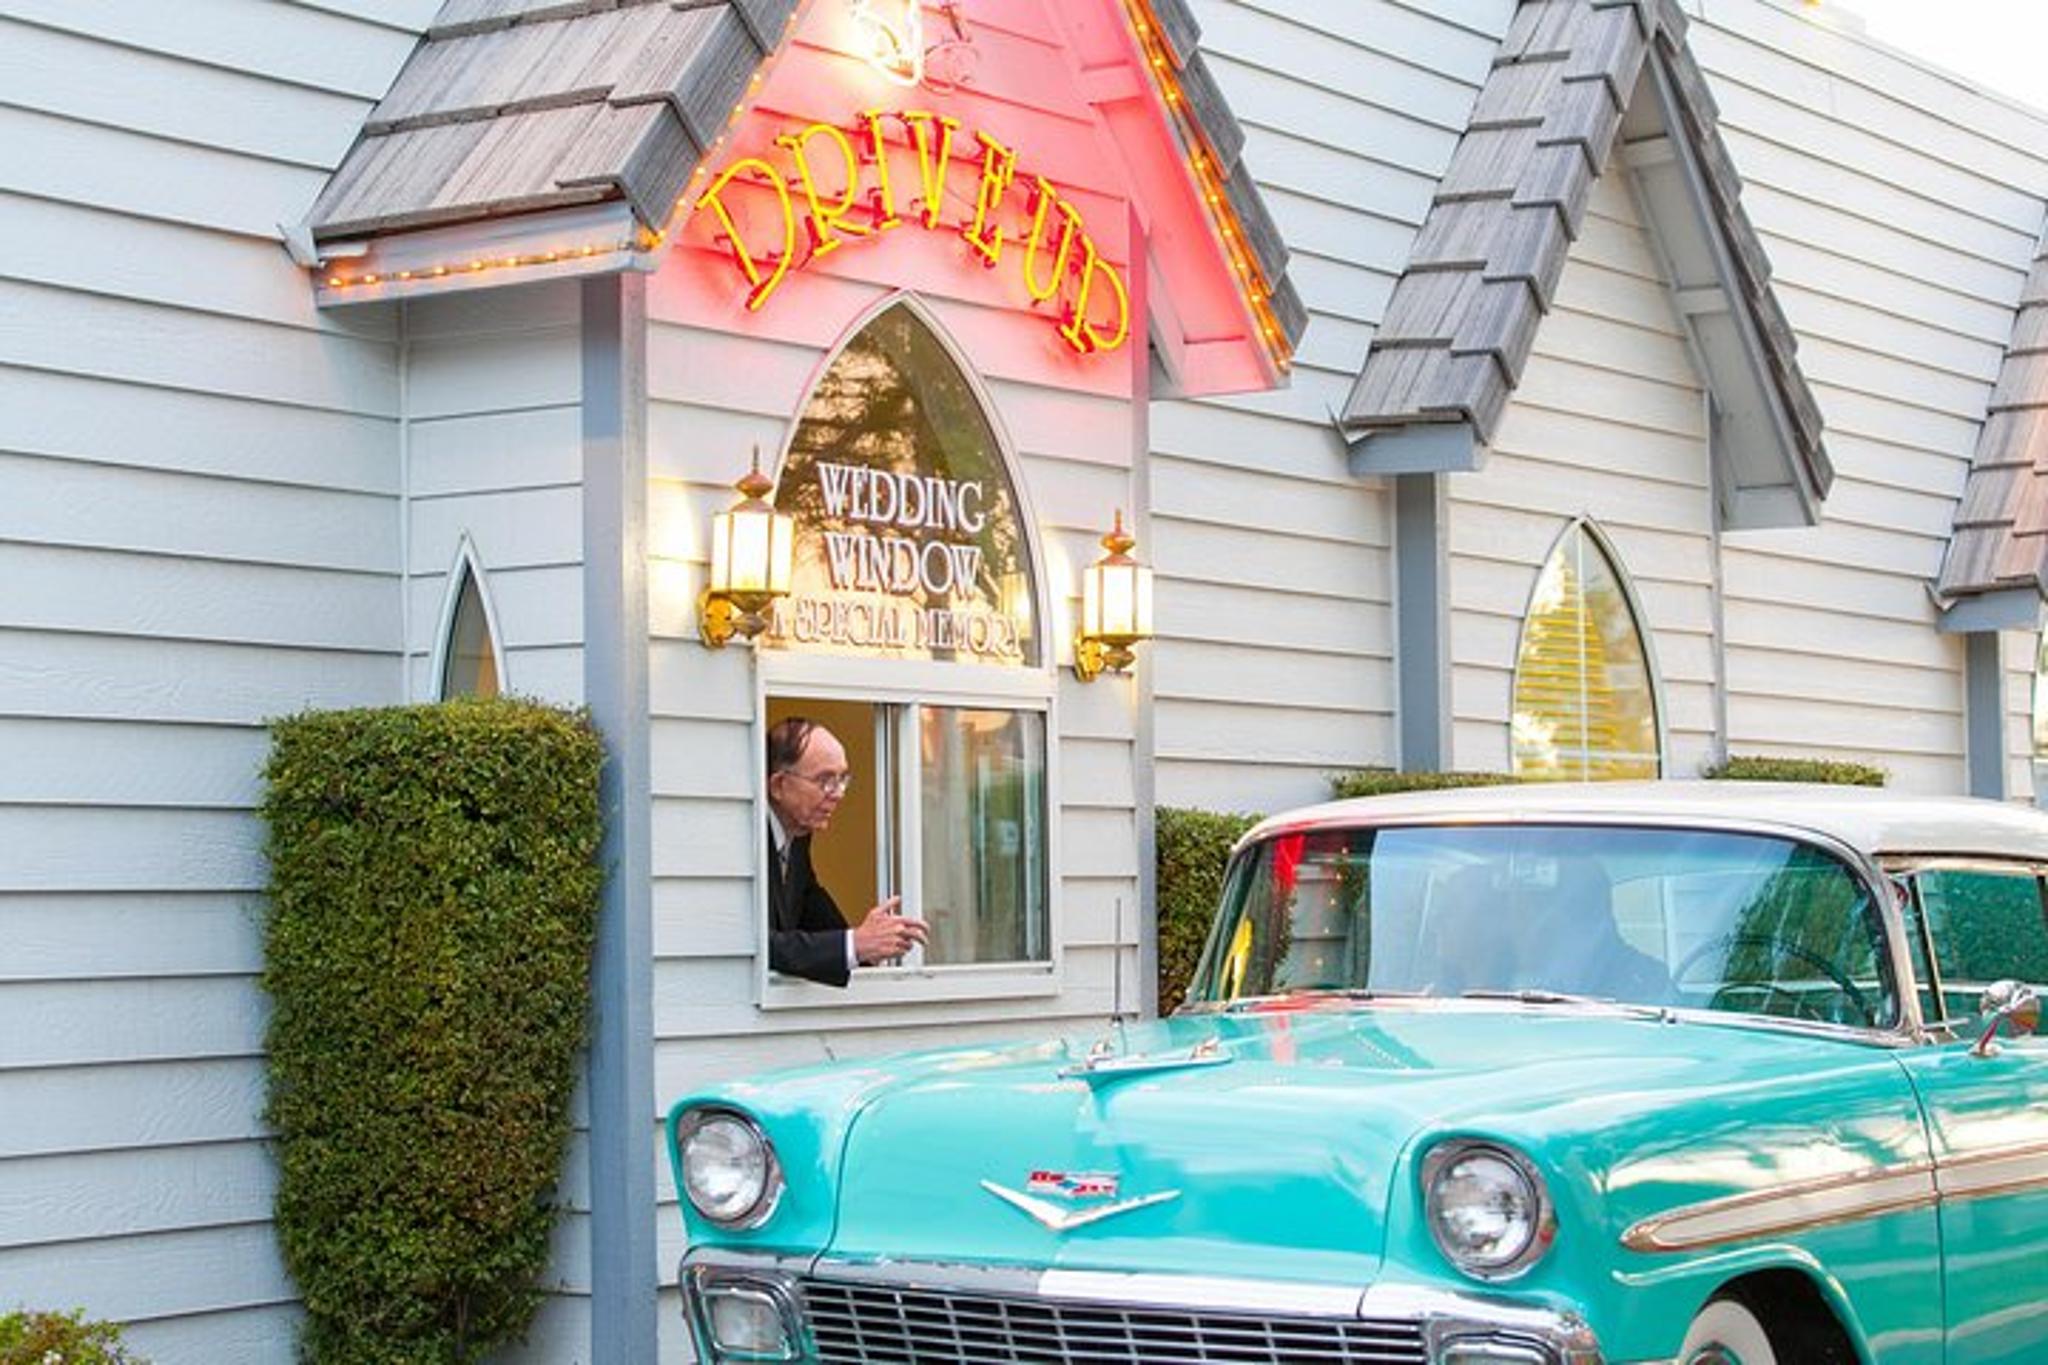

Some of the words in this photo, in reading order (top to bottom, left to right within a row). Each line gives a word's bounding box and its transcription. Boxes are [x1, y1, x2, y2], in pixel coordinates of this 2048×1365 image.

[696, 109, 1017, 310] DRIVE
[1023, 175, 1128, 353] UP
[816, 461, 986, 533] WEDDING
[823, 531, 983, 600] WINDOW
[794, 597, 907, 646] SPECIAL
